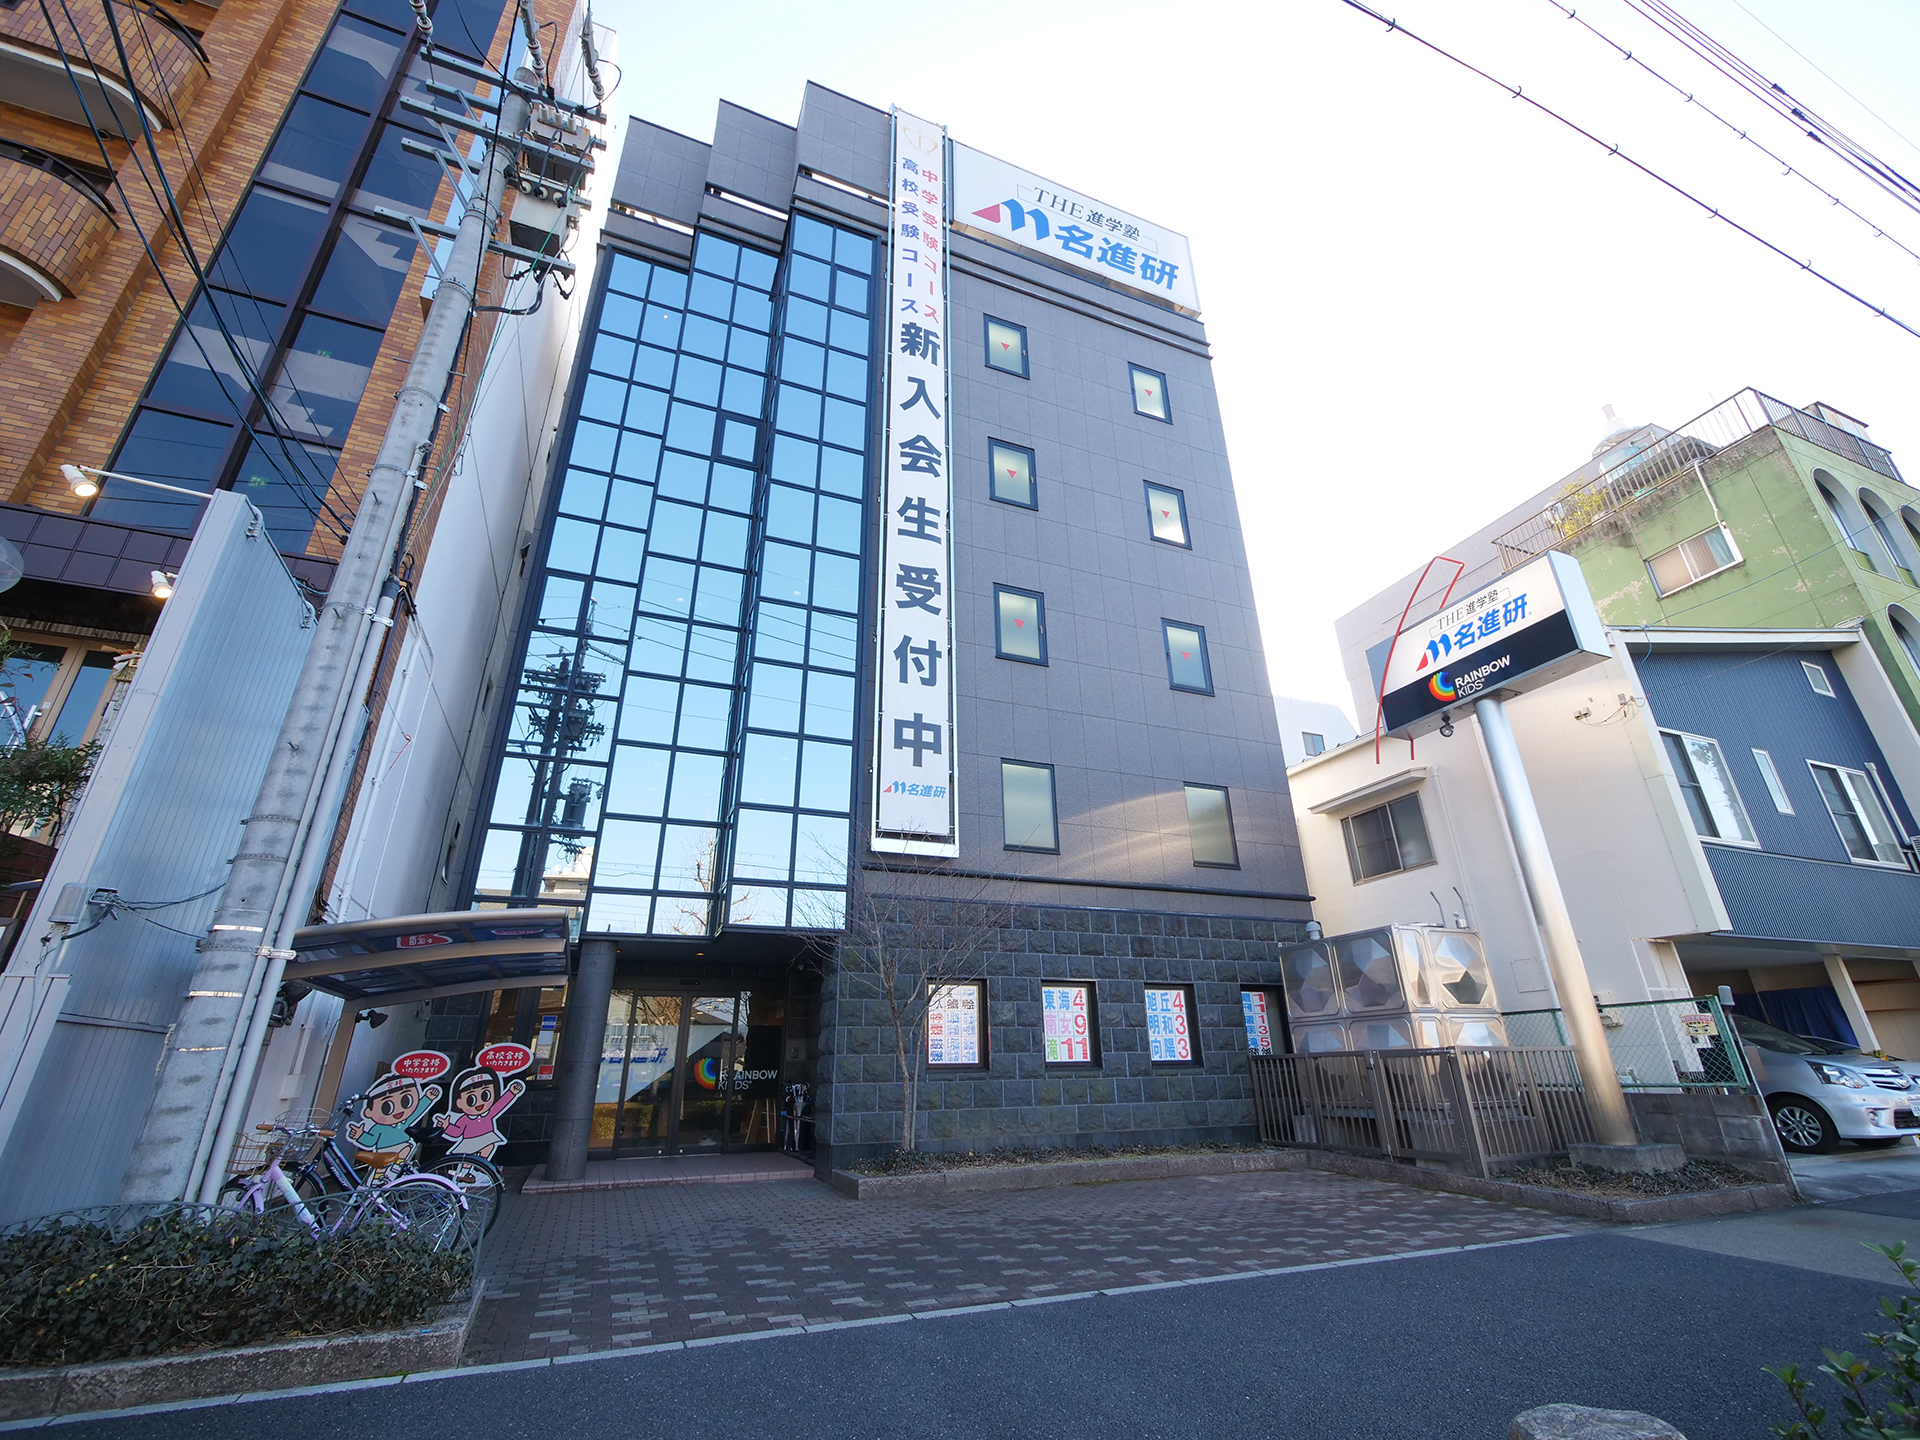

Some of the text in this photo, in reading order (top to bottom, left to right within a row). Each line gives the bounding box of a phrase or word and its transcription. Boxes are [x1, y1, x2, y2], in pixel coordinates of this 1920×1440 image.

[1034, 187, 1141, 242] THE 進学塾
[901, 156, 920, 314] 高校受験コース
[921, 168, 940, 324] 中学受験コース
[1054, 224, 1179, 291] 名進研
[893, 321, 943, 768] 新入会生受付中
[1437, 589, 1498, 630] THE 進学塾
[1454, 593, 1528, 650] 名進研
[1455, 654, 1510, 689] RAINBOW
[907, 783, 947, 799] 名進研
[1043, 989, 1085, 1011] 東海 4
[1147, 991, 1184, 1012] 旭丘 4
[1044, 1013, 1087, 1035] 南女 9
[1148, 1014, 1187, 1035] 明和 3
[486, 1050, 524, 1060] 高校合格
[1061, 1038, 1088, 1060] 11
[1150, 1038, 1189, 1059] 向陽 3
[403, 1058, 441, 1068] 中学合格
[719, 1069, 778, 1081] RAINBOW
